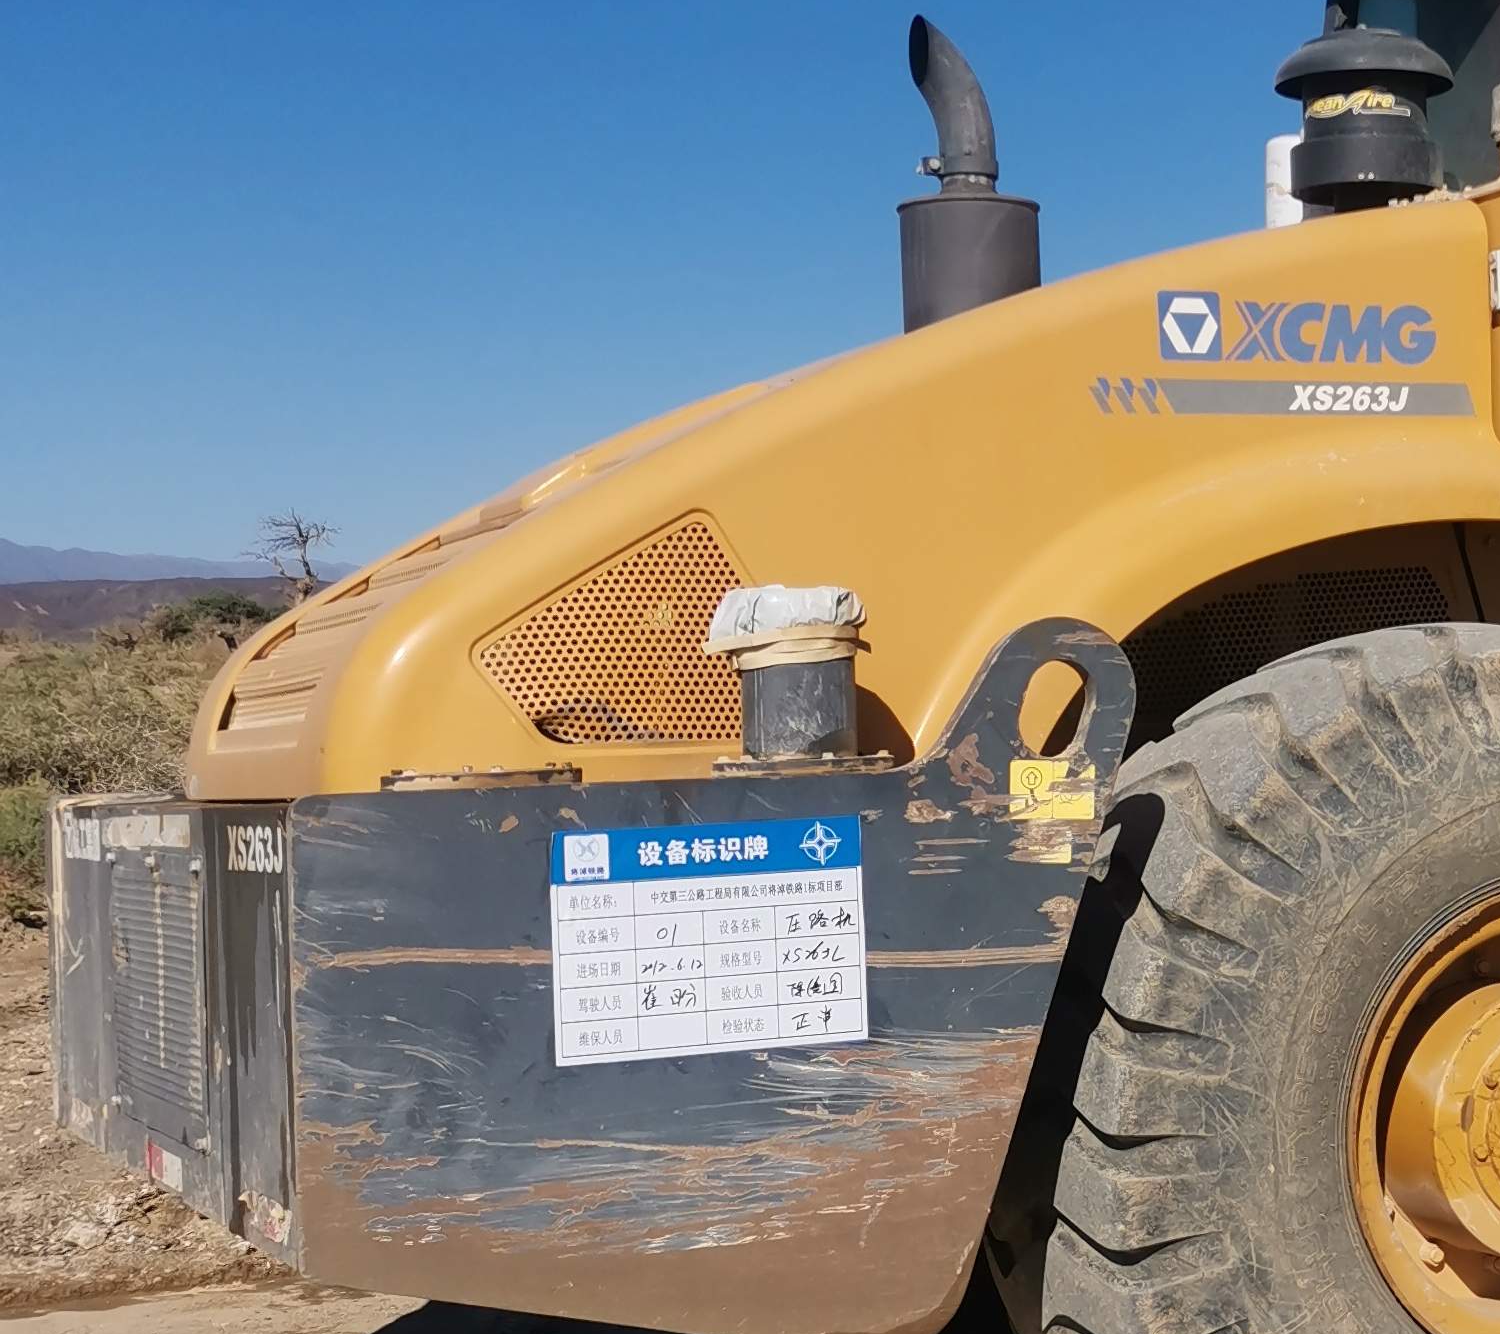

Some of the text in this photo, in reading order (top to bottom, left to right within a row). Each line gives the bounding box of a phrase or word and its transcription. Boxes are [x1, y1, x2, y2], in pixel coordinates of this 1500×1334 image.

[1225, 300, 1437, 365] XCMG
[1288, 384, 1409, 412] XS263J
[226, 825, 283, 874] XS263J
[636, 834, 770, 868] 设备标识牌
[656, 923, 678, 946] 01
[718, 917, 762, 936] 设备名称
[575, 928, 621, 946] 设备编号
[719, 951, 763, 970] 规格型号
[576, 962, 622, 980] 进场日期
[721, 982, 765, 1002] 验收人员
[577, 994, 623, 1013] 驾驶人员
[721, 1016, 766, 1035] 检验状态
[578, 1029, 624, 1047] 维保人员
